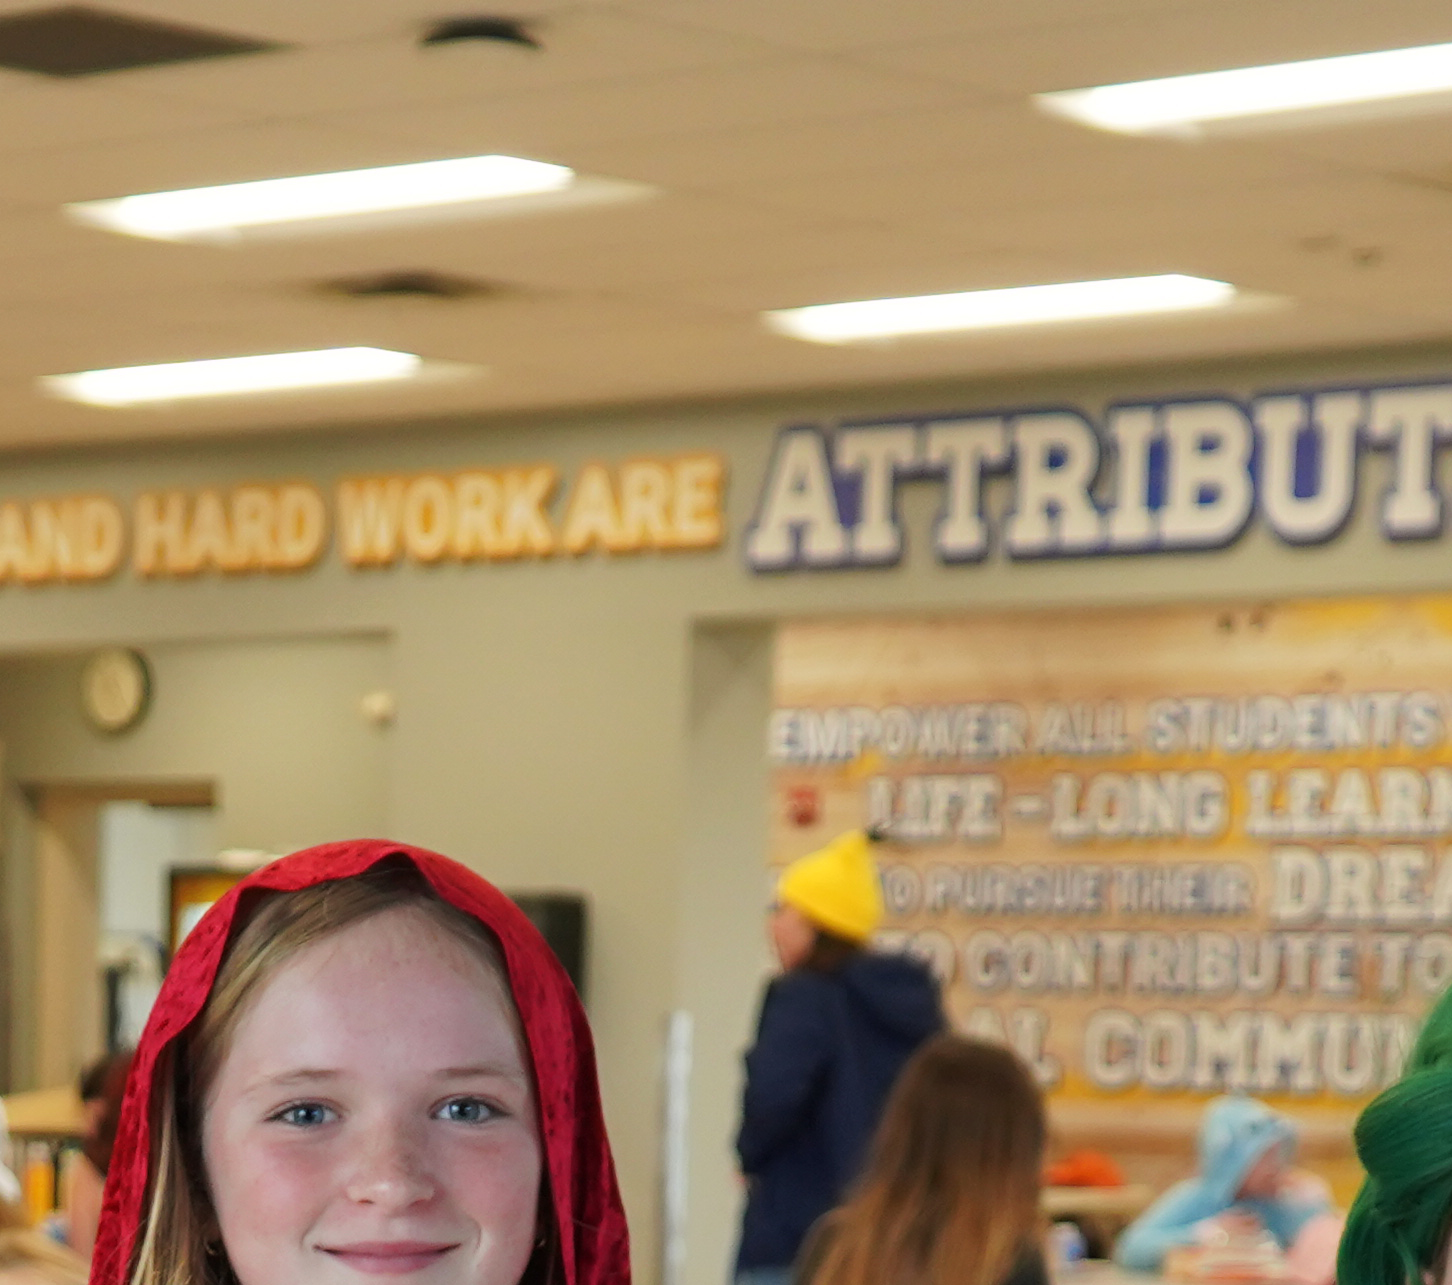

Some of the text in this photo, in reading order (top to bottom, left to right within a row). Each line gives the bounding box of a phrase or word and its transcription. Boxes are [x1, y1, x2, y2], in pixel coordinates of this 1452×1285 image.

[133, 484, 326, 577] HARD
[337, 463, 559, 568] WORK
[560, 453, 725, 556] ARE
[769, 704, 1029, 764] EMPOWER
[1035, 701, 1130, 757] ALL
[1146, 689, 1444, 755] STUDENTS
[966, 930, 1358, 998] CONTRIBUTE
